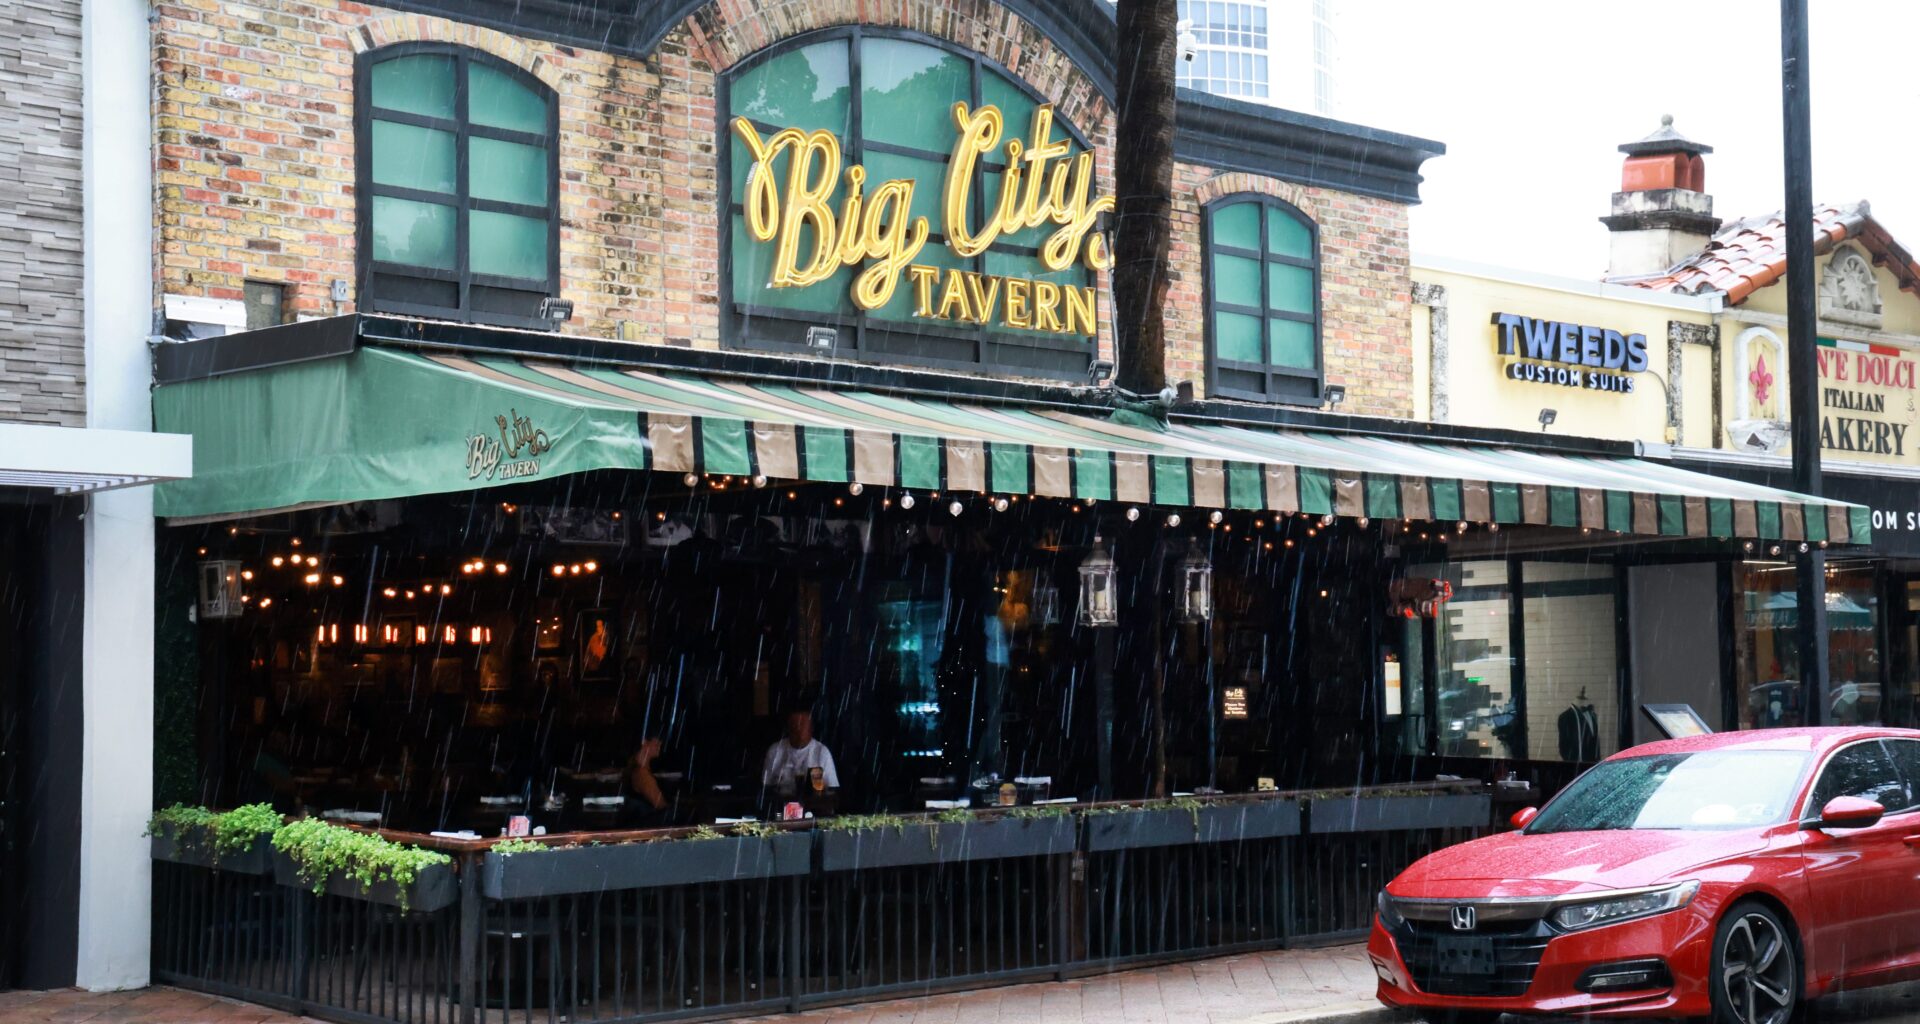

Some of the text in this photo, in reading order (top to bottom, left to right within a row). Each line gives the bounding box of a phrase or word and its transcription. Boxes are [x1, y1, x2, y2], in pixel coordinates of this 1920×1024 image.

[730, 101, 1115, 310] Big City
[907, 264, 1097, 337] TAVERN
[1491, 312, 1649, 373] TWEEDS
[1511, 362, 1635, 394] CUSTOM SUITS
[1817, 348, 1917, 390] N'E DOLCI
[1824, 387, 1884, 414] ITALIAN
[465, 407, 550, 481] Big City
[1819, 416, 1909, 456] AKERY
[499, 459, 541, 480] TAVERN
